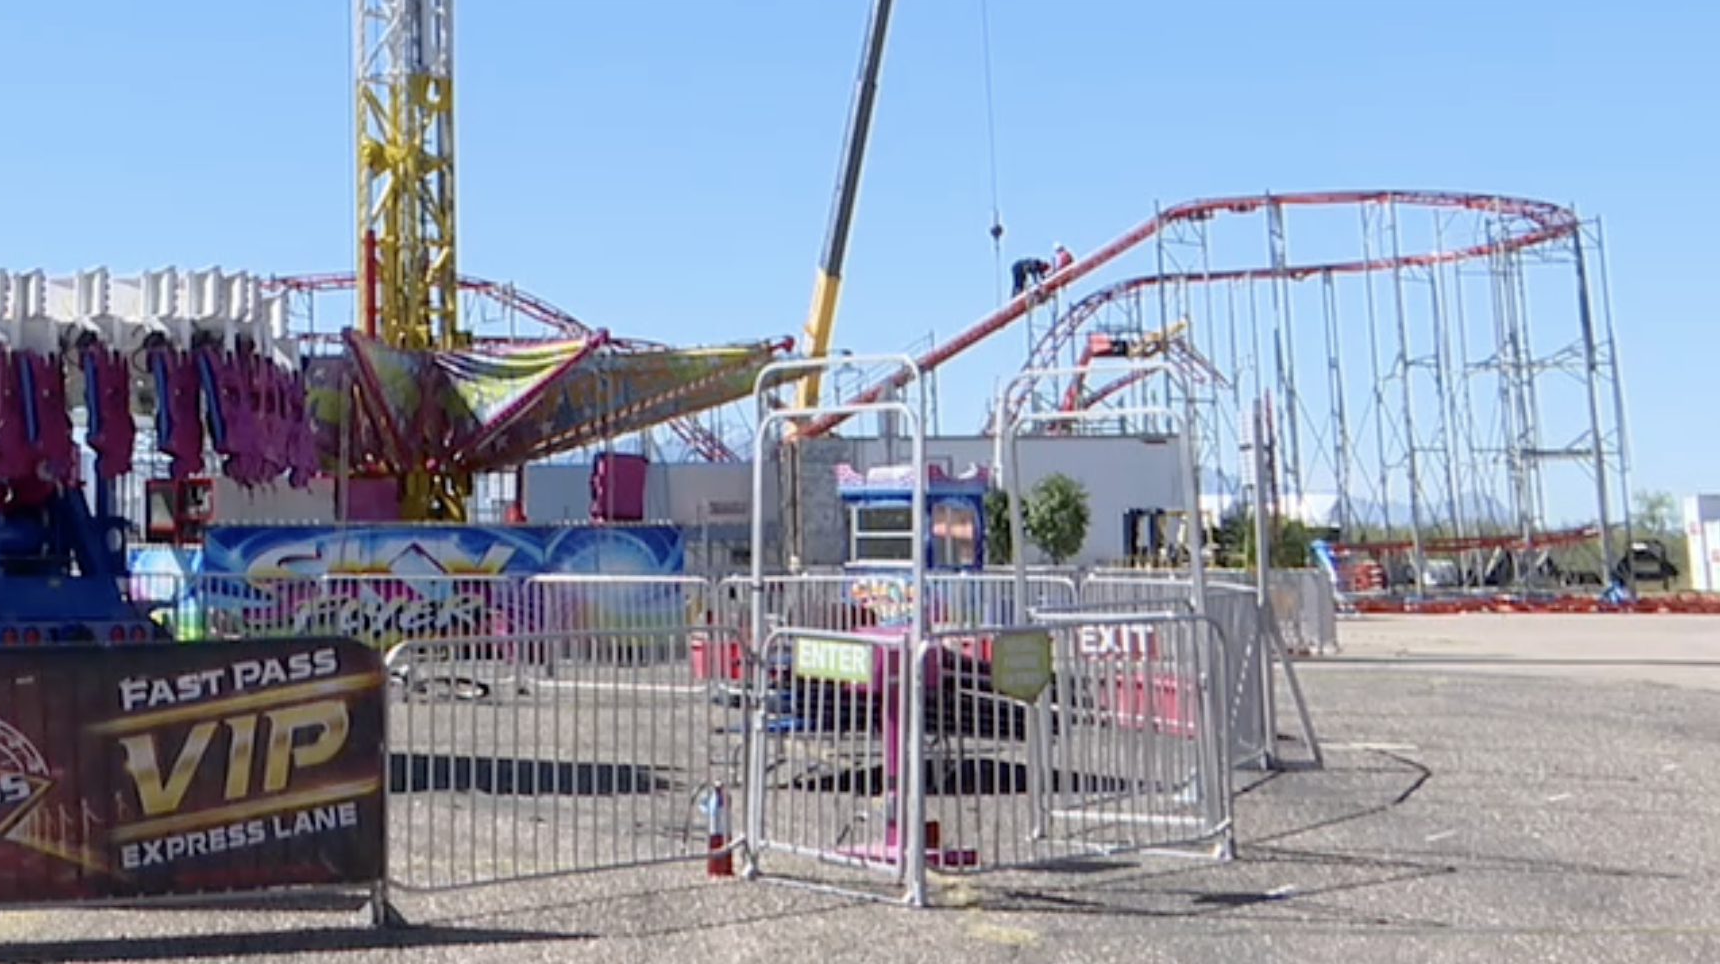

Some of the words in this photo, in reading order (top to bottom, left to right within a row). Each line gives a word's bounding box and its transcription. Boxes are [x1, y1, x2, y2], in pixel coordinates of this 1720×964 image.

[799, 638, 867, 675] ENTER
[1080, 624, 1154, 654] EXIT
[118, 668, 225, 712] FAST
[232, 647, 337, 690] PASS
[118, 699, 350, 816] VIP
[121, 819, 266, 869] EXPRESS
[272, 801, 357, 837] LANE
